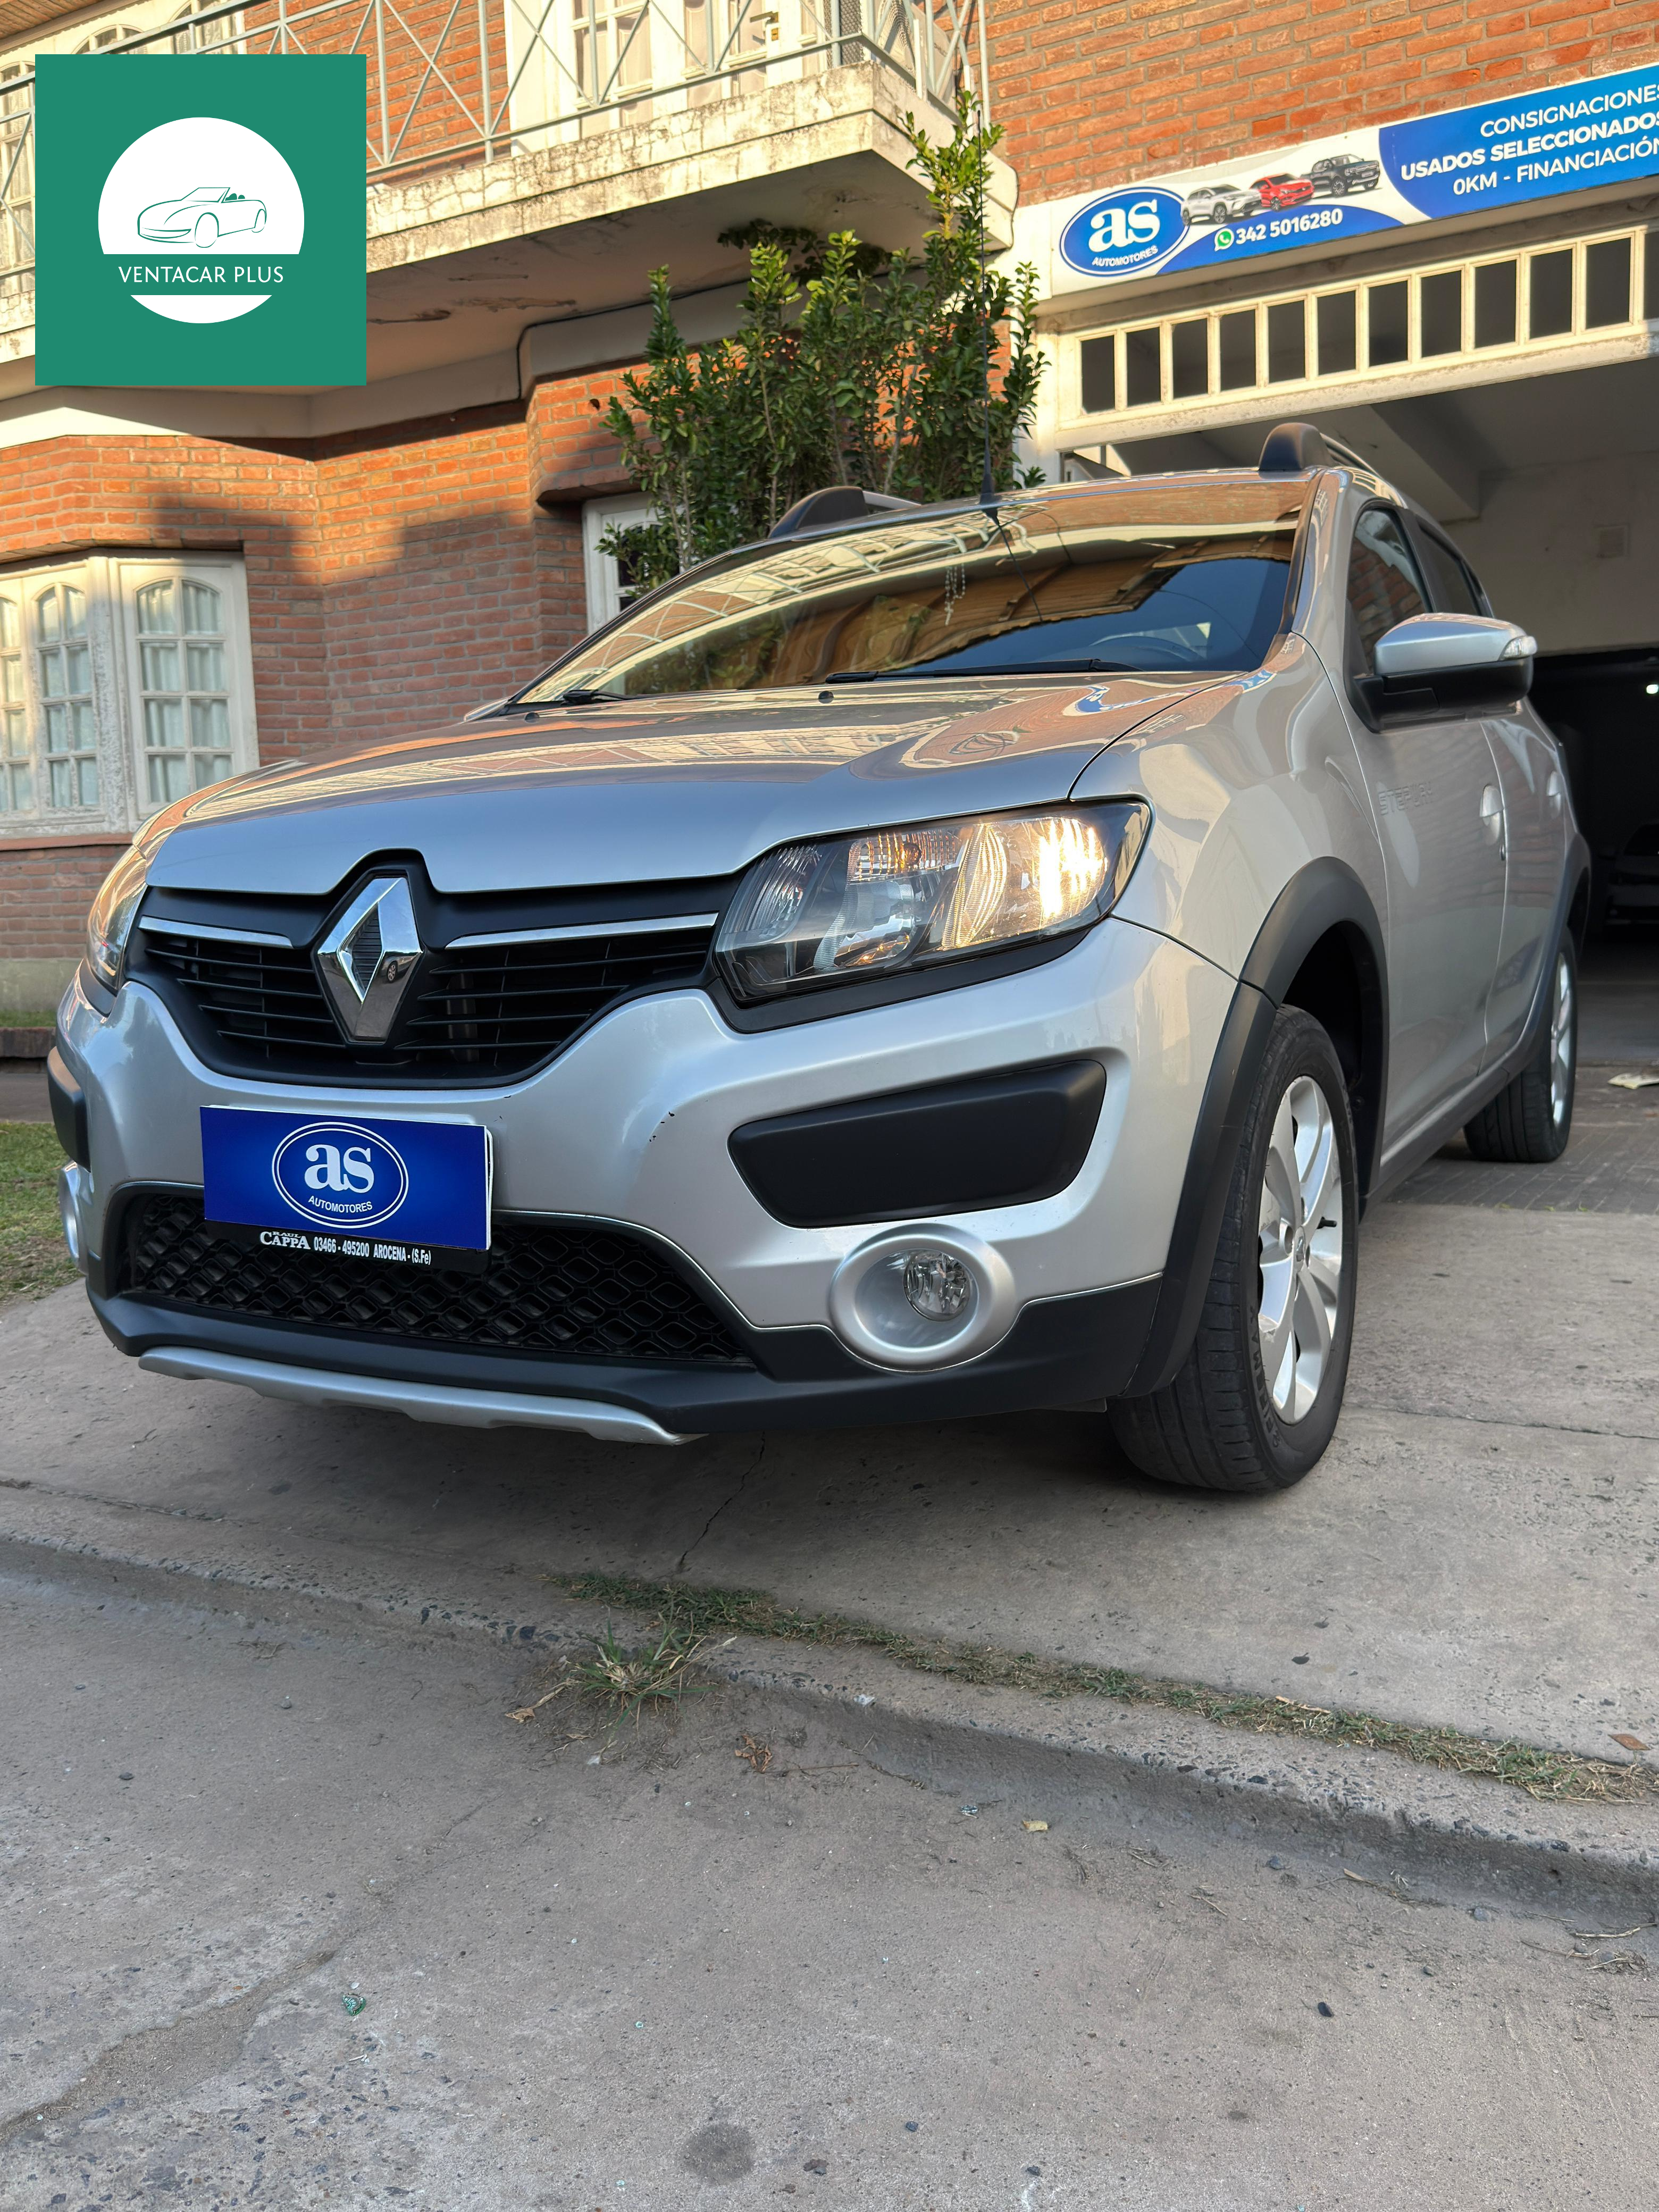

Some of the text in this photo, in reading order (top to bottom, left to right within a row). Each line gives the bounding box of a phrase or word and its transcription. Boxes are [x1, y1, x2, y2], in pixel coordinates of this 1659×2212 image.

[1480, 84, 1659, 137] CONSIGNACIONE
[1401, 111, 1659, 180] USADOS SELECCIONADO
[1088, 199, 1160, 253] as
[1236, 208, 1343, 245] 342 5016280
[1092, 245, 1158, 266] AUTOMOTORES
[305, 1144, 374, 1193] as
[308, 1195, 373, 1213] AUTOMOTORES
[260, 1231, 311, 1250] CAPPA
[314, 1236, 337, 1253] 03466
[342, 1240, 370, 1258] 495200
[373, 1244, 406, 1262] AROCENA
